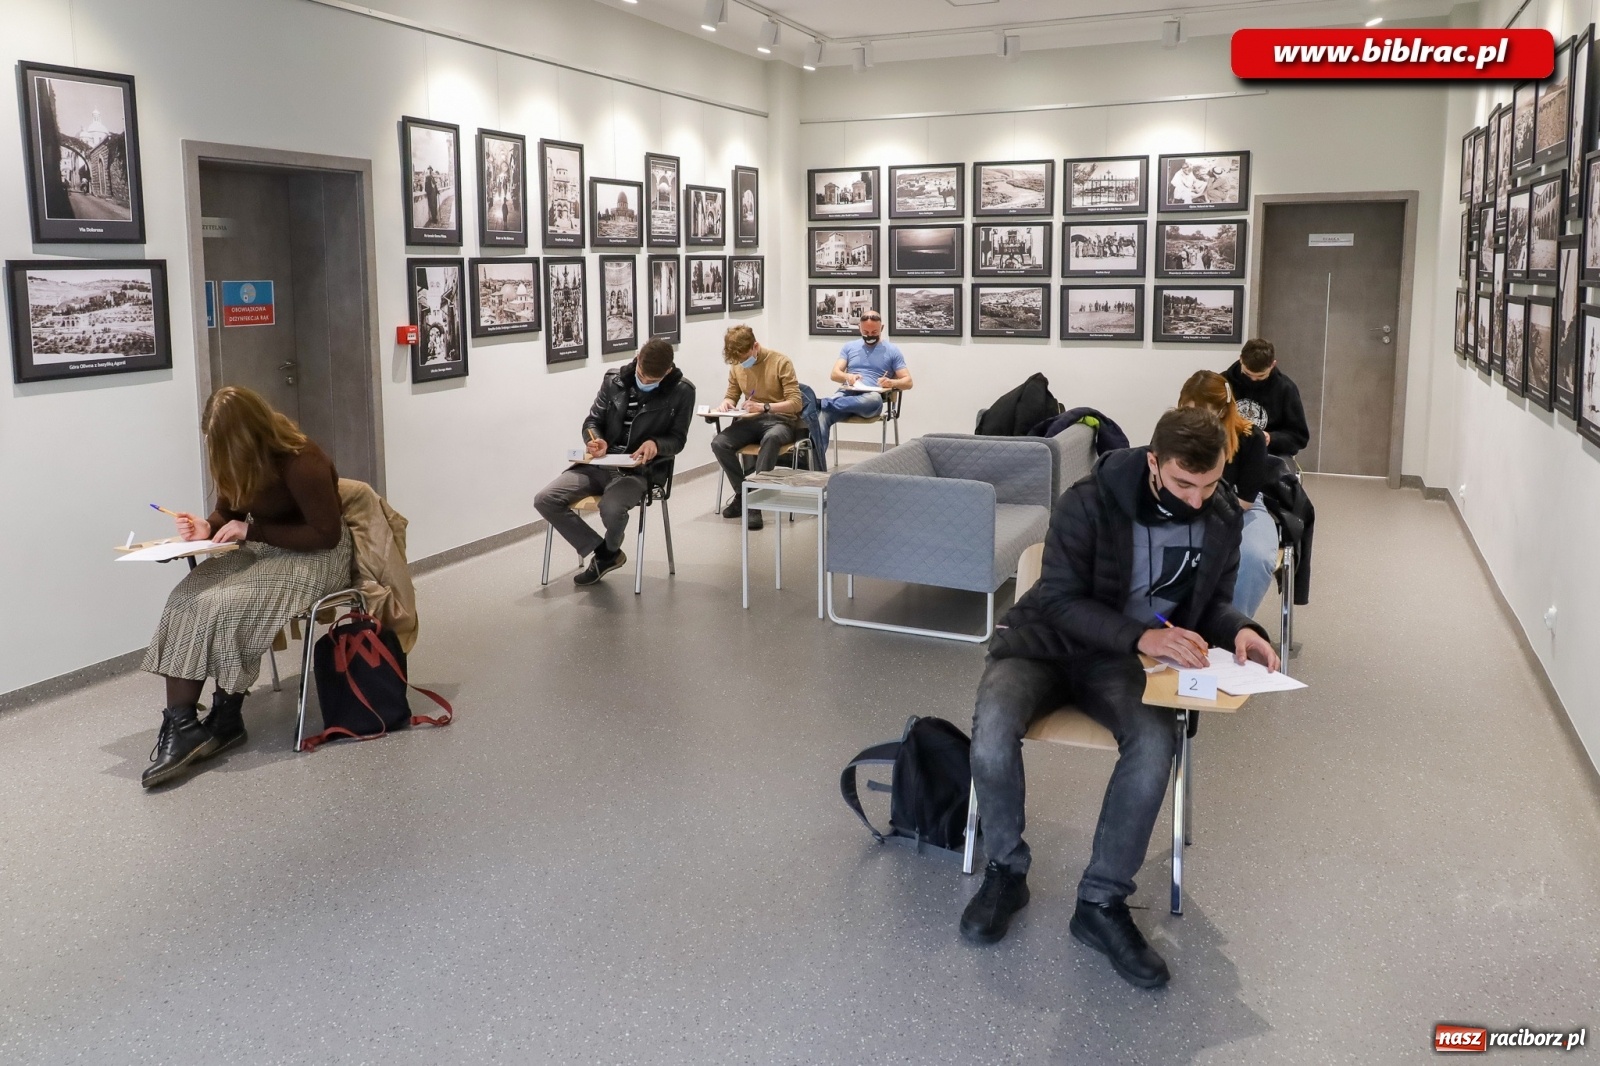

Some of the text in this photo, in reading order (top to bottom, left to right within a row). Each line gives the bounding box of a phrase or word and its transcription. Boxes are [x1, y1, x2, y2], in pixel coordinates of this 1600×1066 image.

[202, 224, 227, 232] ZYTELNIA
[231, 306, 267, 314] OBOWIĄZKOWA
[1189, 677, 1199, 691] 2
